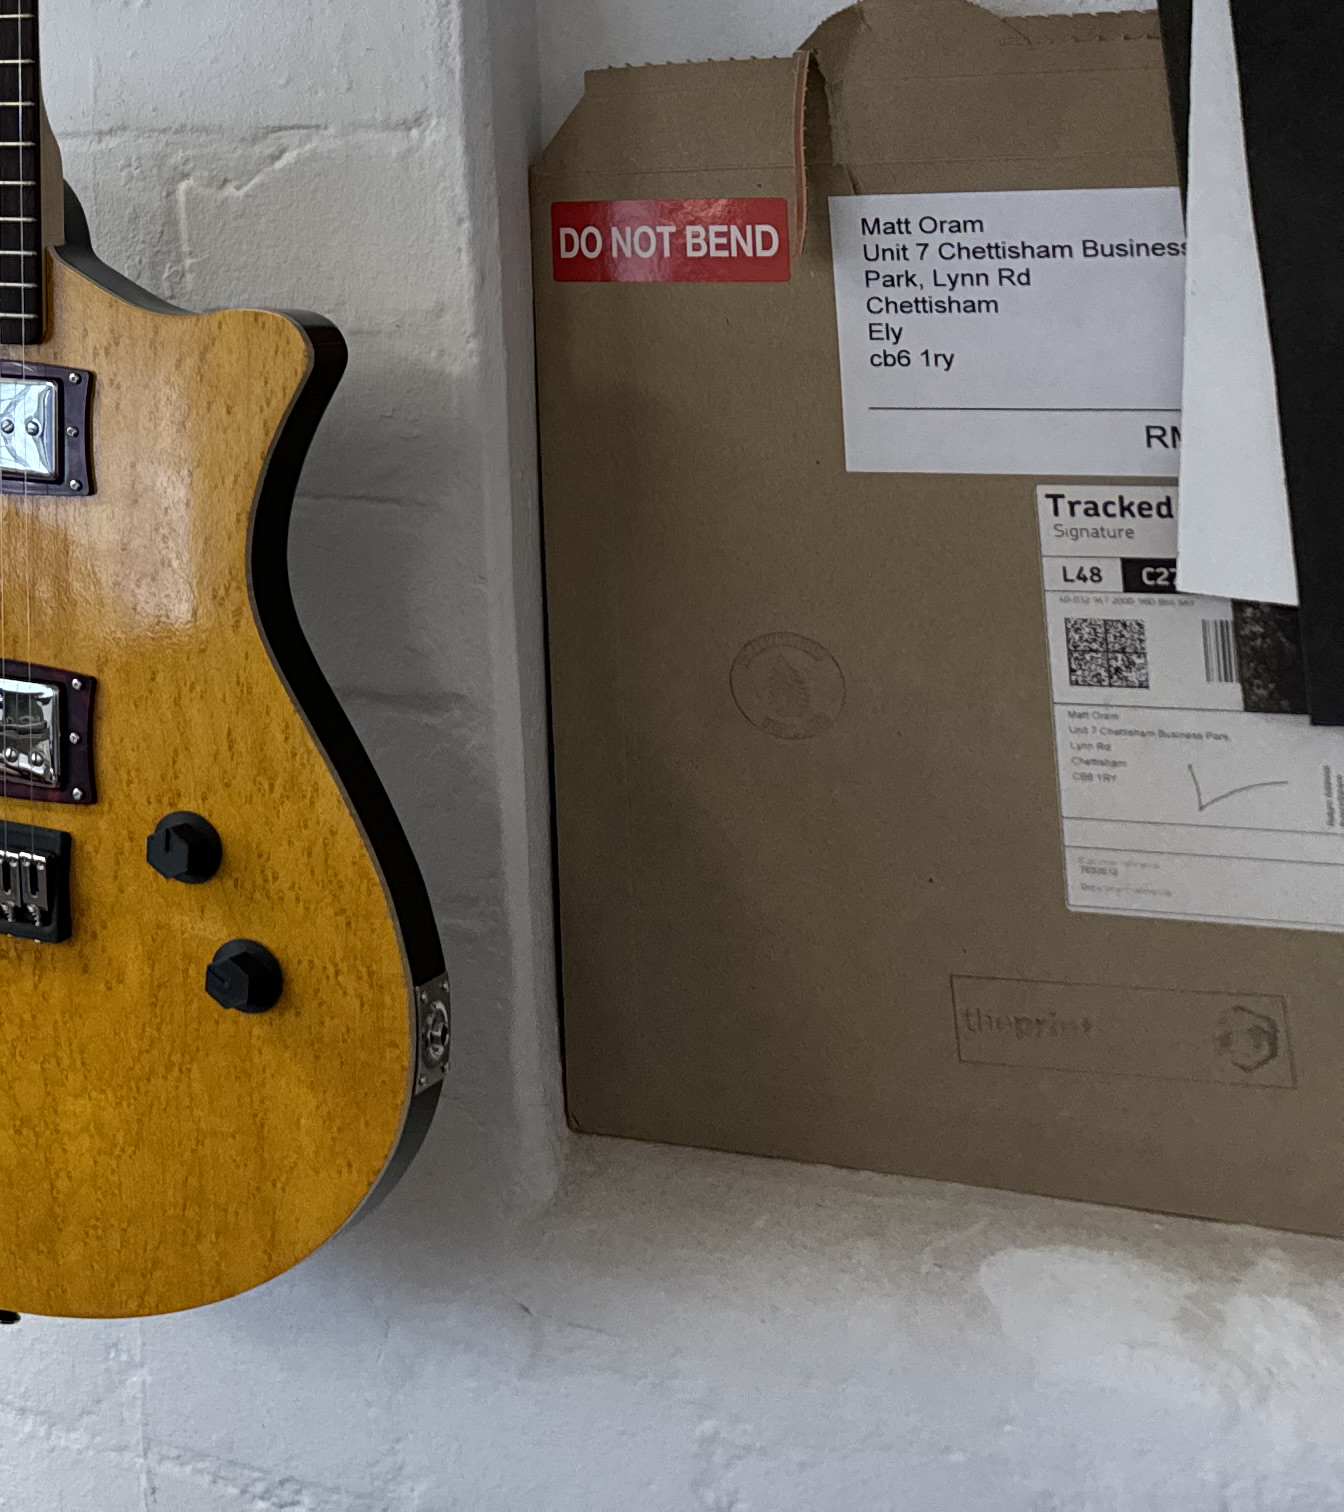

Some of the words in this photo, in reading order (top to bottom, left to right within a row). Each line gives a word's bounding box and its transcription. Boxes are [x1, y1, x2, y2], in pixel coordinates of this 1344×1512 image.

[861, 217, 912, 236] Matt
[918, 215, 984, 234] Oram
[559, 225, 603, 259] DO
[611, 225, 676, 259] NOT
[685, 224, 780, 258] BEND
[863, 242, 910, 262] Unit
[915, 243, 929, 261] 7
[937, 240, 1074, 261] Chettisham
[864, 269, 924, 291] Park,
[932, 268, 990, 292] Lynn
[998, 267, 1031, 287] Rd
[866, 295, 999, 315] Chettisham
[868, 323, 904, 345] Ely
[870, 349, 911, 368] cb6
[920, 349, 955, 372] 1ry
[1045, 493, 1174, 519] Tracked
[1053, 523, 1135, 542] Signature
[1062, 565, 1103, 583] L48
[1067, 710, 1089, 719] Matt
[1068, 725, 1089, 735] Unit
[1157, 729, 1204, 740] Business
[1069, 741, 1093, 752] Lynn
